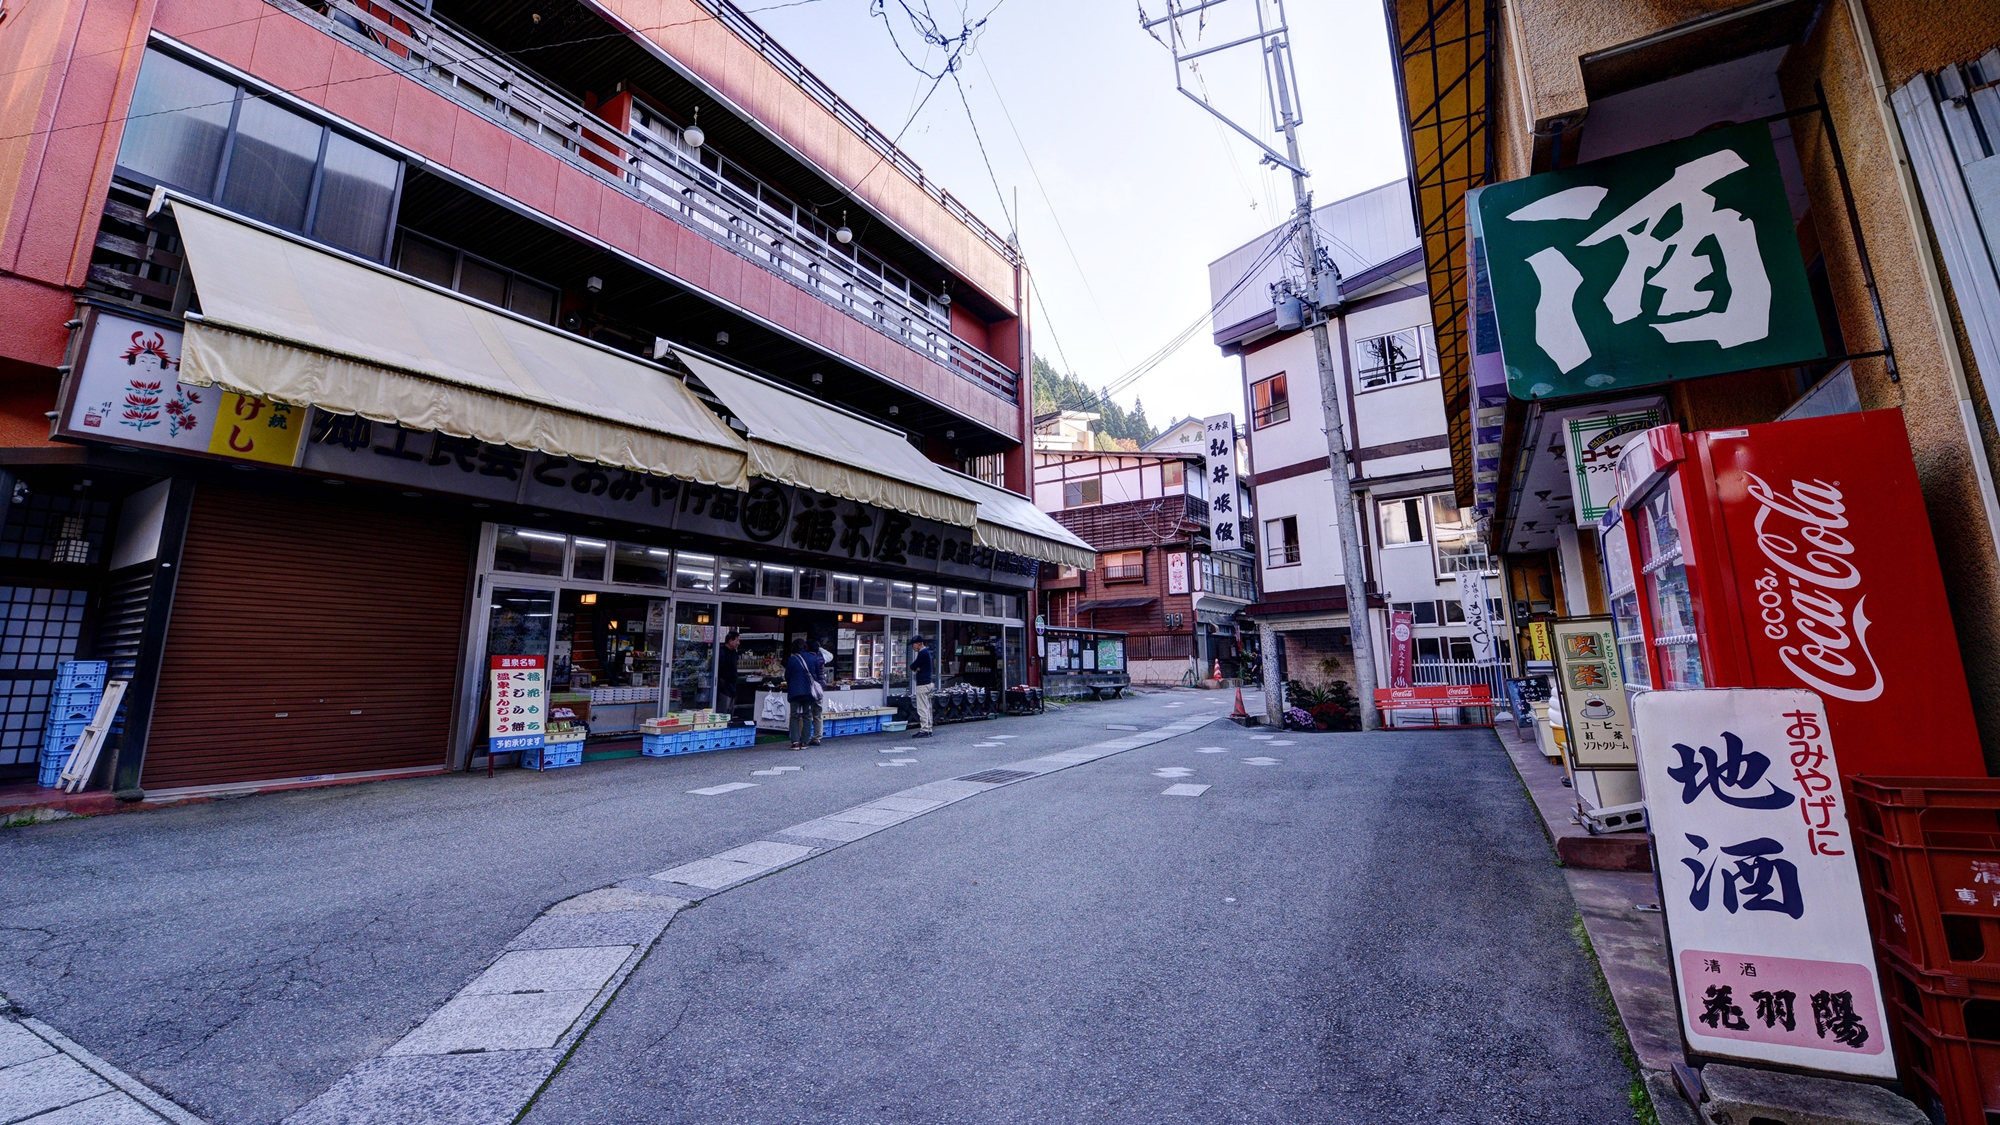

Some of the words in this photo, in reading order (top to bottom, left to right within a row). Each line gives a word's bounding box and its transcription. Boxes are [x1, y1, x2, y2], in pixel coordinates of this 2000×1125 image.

[1505, 148, 1772, 375] 酒
[1589, 420, 1652, 448] 当店オリジナル
[1745, 470, 1885, 703] Coca-Cola
[501, 658, 537, 667] 温泉名物
[1397, 643, 1406, 675] 使えます
[1567, 635, 1604, 687] 喫茶
[496, 672, 511, 733] 温泉まんじゅう
[1579, 721, 1625, 731] コーヒー
[1585, 731, 1625, 741] 紅茶
[496, 736, 541, 749] 予約承ります
[1583, 741, 1630, 751] ソフトクリーム
[1782, 709, 1846, 857] おみやげに
[1667, 731, 1804, 920] 地酒
[1704, 957, 1758, 978] 清酒
[1698, 984, 1870, 1049] 花羽陽
